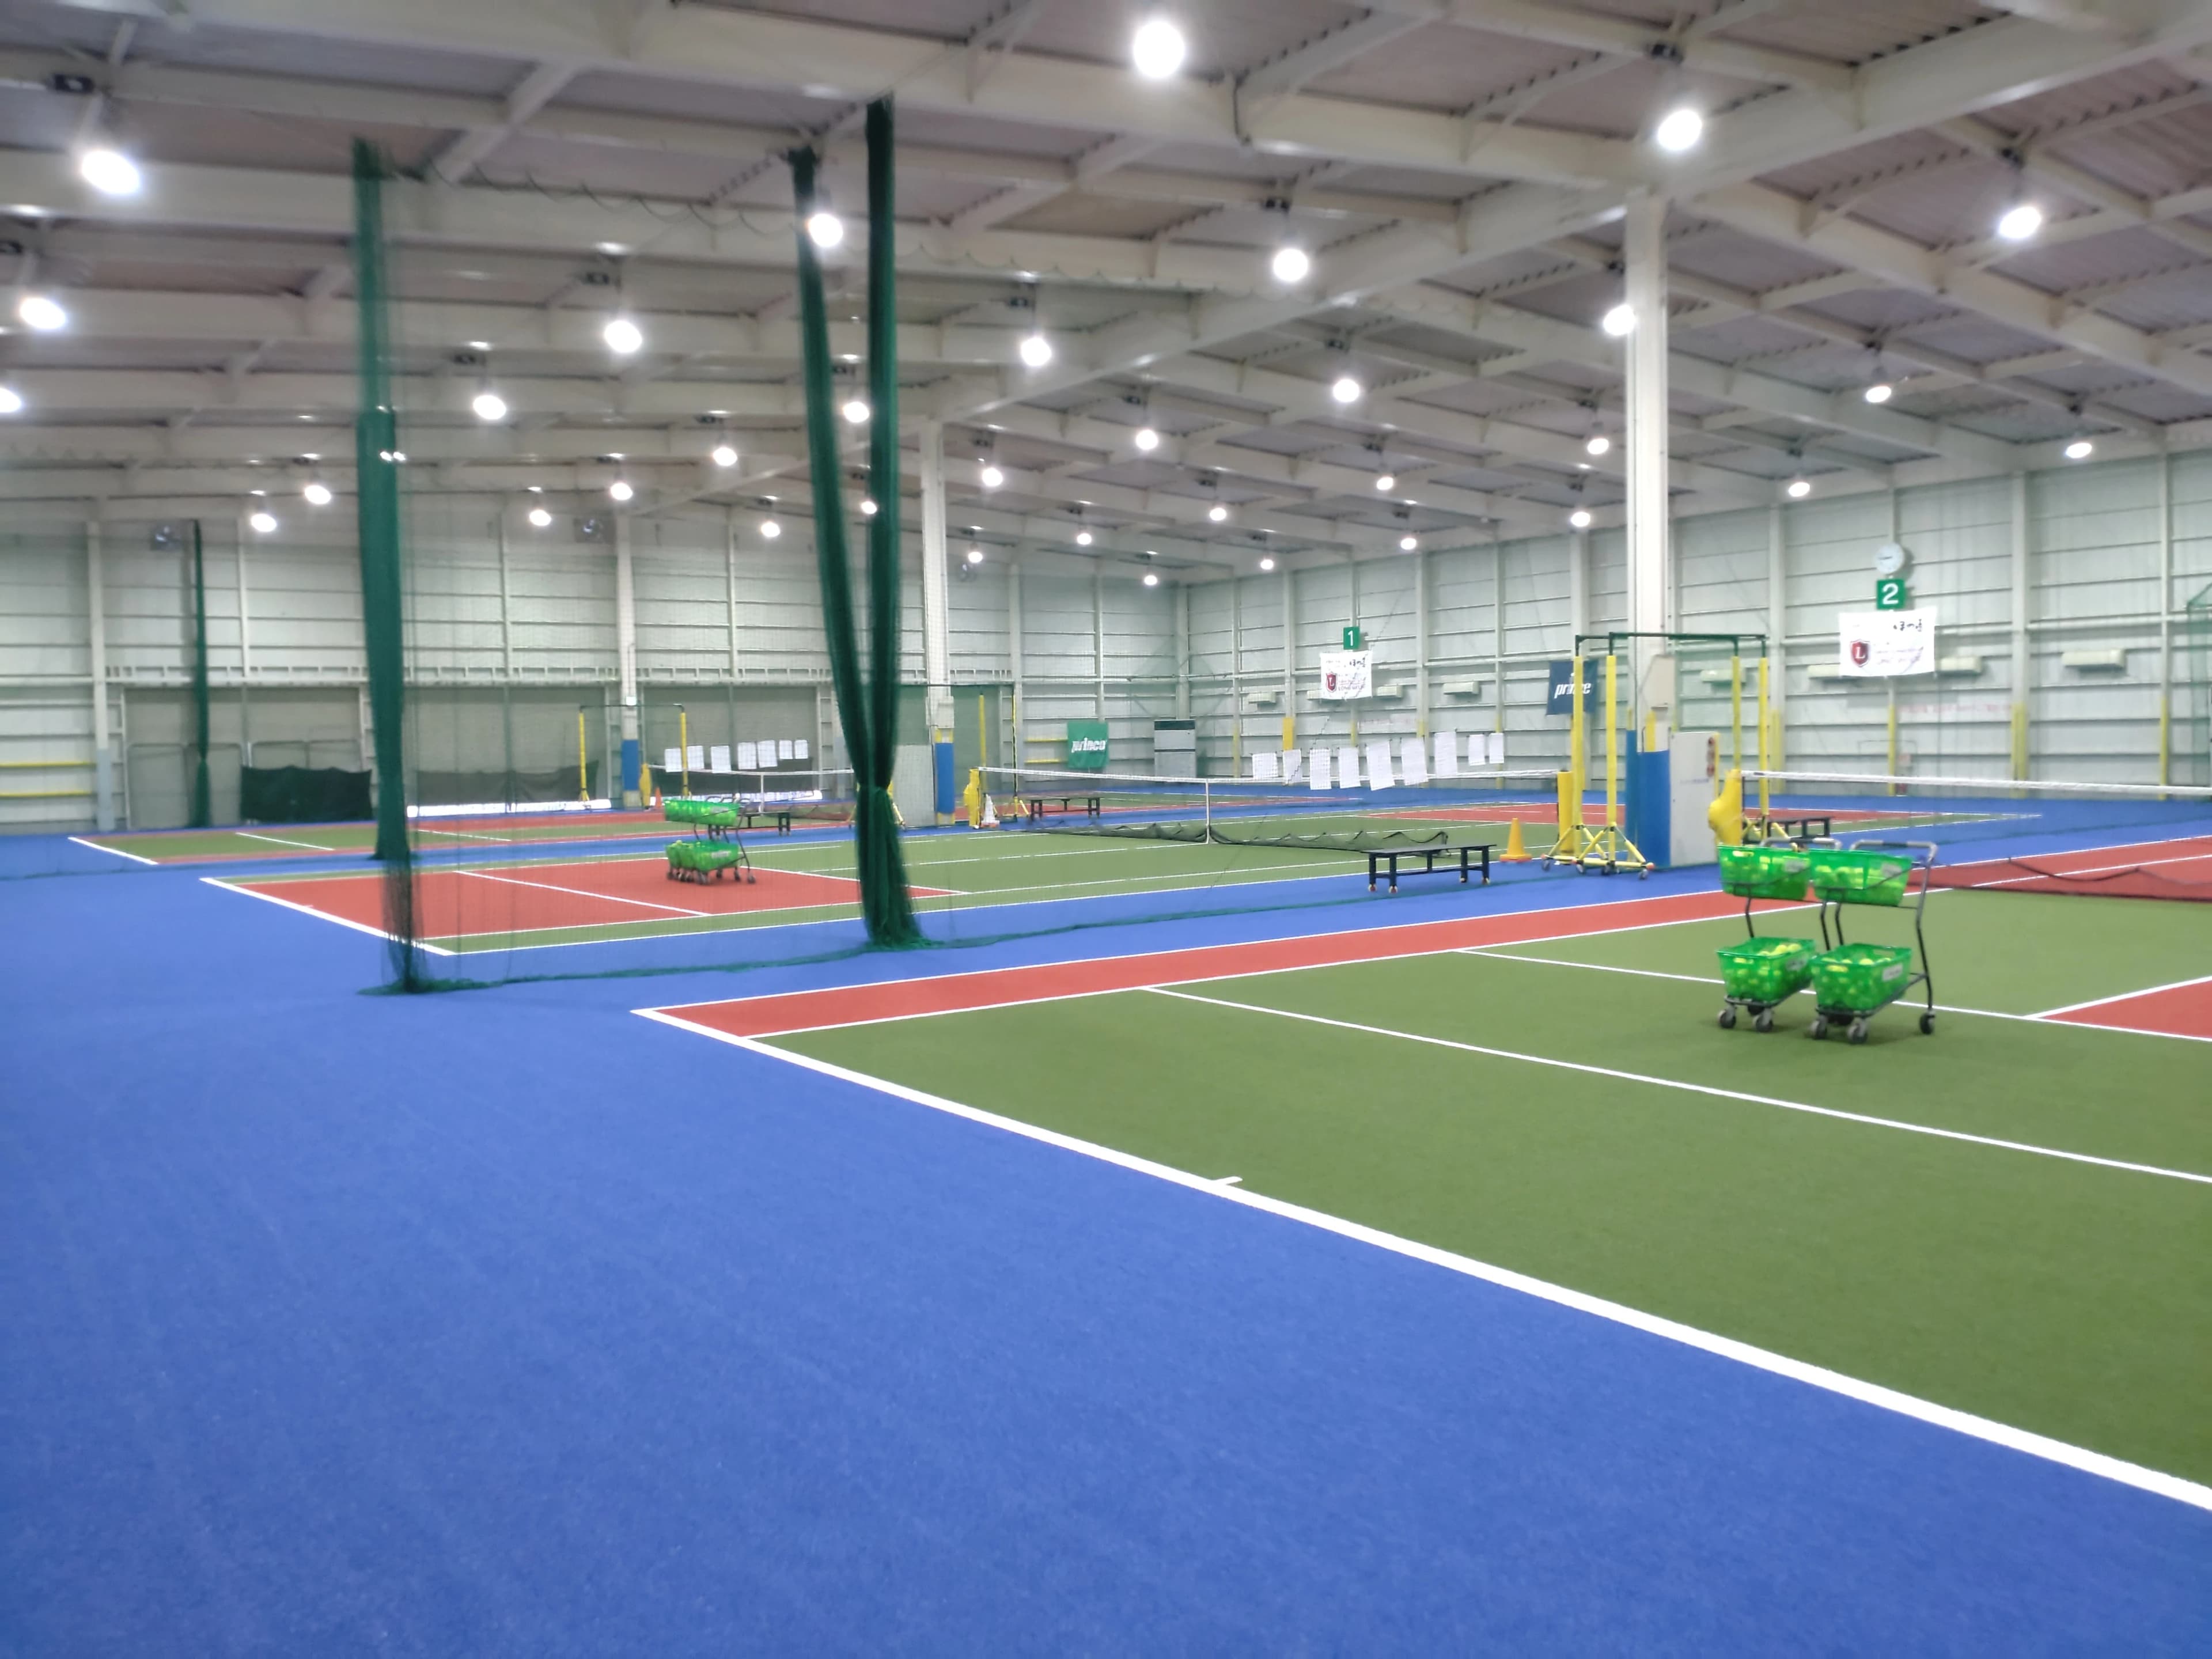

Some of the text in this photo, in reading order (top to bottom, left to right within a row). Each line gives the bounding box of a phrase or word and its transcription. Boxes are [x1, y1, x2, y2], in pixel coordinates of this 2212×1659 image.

[1881, 583, 1900, 605] 2
[1347, 630, 1354, 646] 1
[1855, 646, 1866, 659] L
